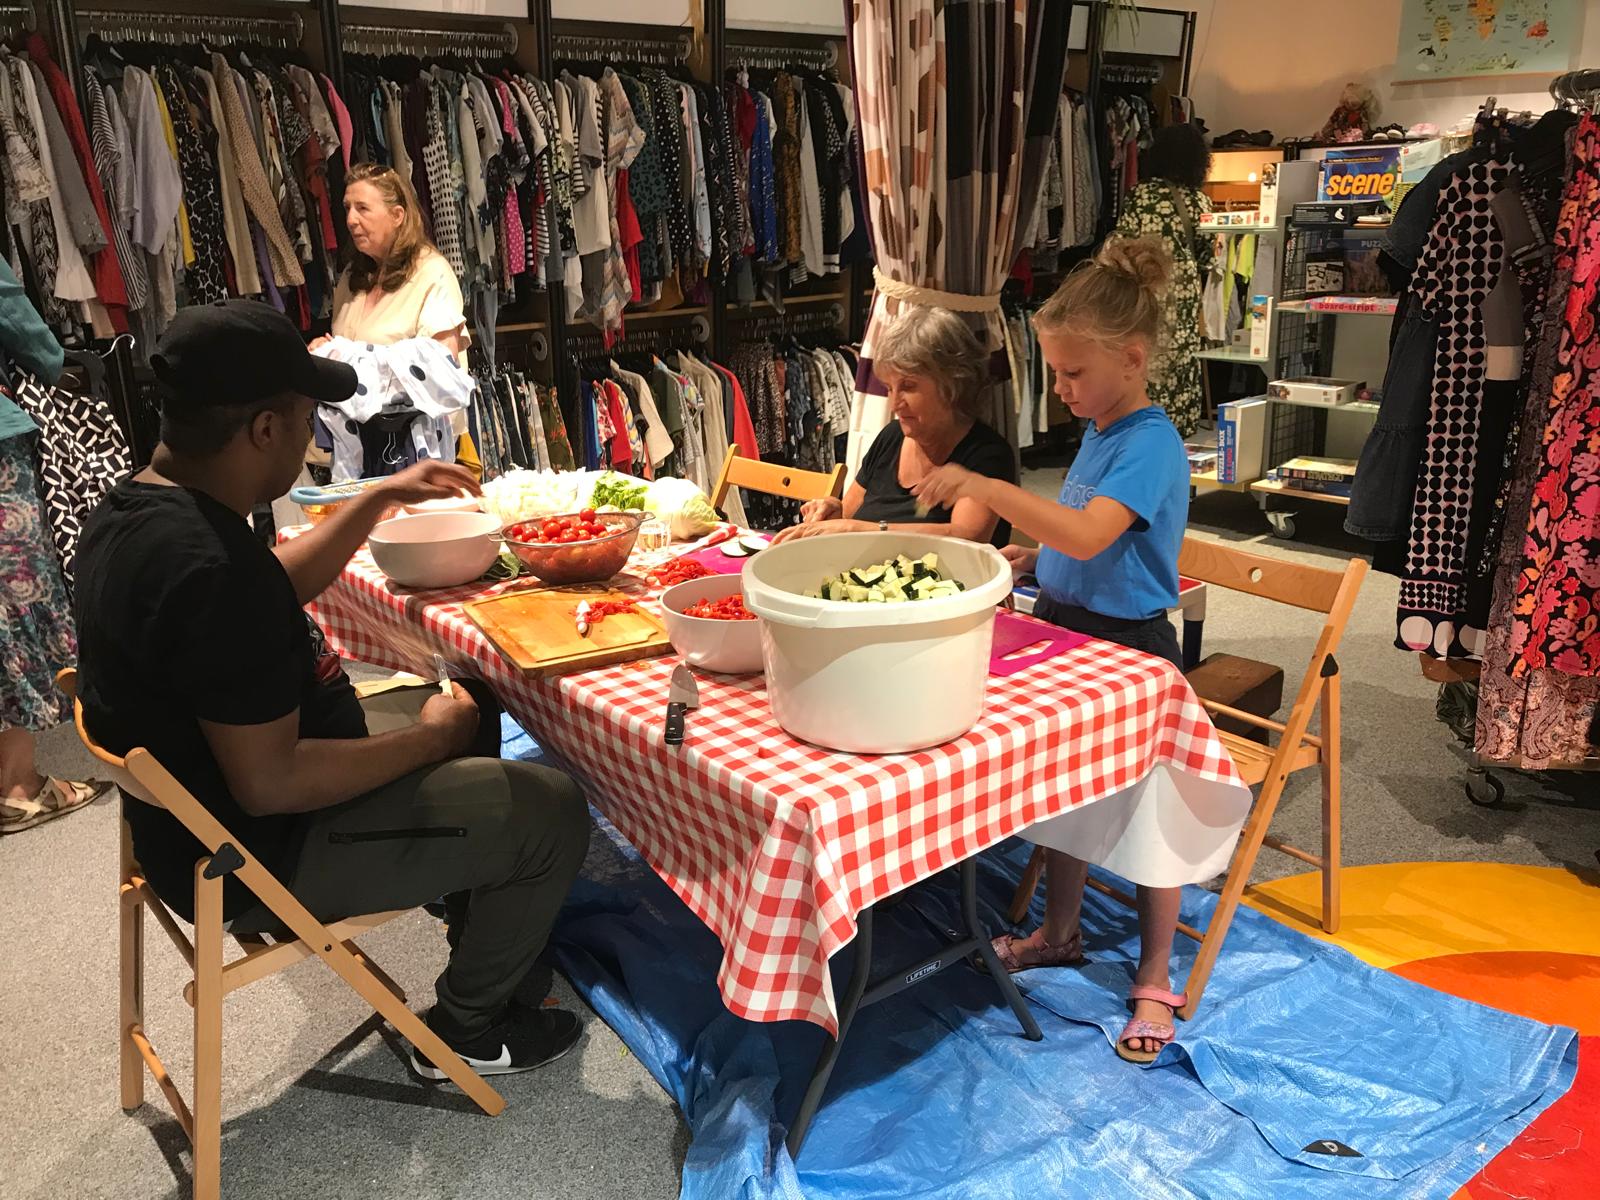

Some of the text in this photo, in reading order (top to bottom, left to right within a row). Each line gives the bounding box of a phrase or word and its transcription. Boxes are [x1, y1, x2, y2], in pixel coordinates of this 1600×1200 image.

[1326, 173, 1394, 196] scene
[1307, 471, 1344, 482] STRATEGO
[910, 963, 937, 981] LIFETIME
